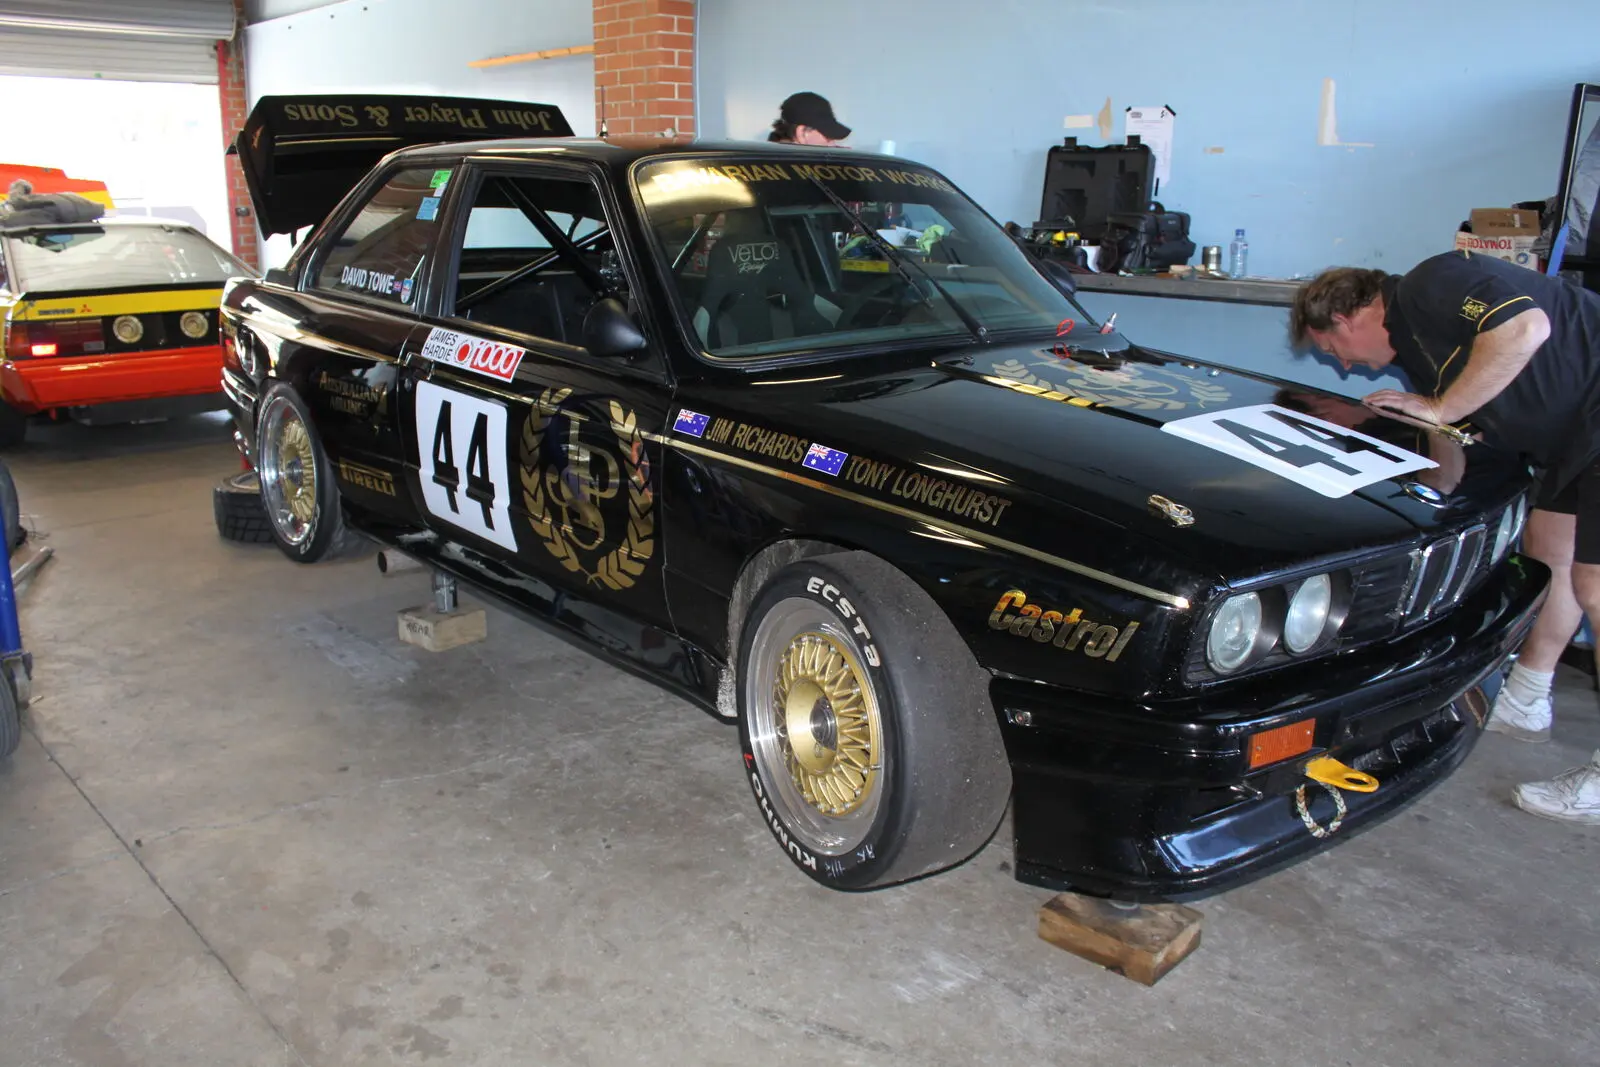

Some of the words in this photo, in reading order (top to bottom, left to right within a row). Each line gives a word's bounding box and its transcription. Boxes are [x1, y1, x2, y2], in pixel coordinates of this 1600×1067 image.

[284, 103, 359, 127] Sons
[364, 105, 391, 127] &
[404, 103, 488, 130] Player
[493, 107, 554, 131] John
[791, 164, 885, 184] MOTOR
[878, 168, 958, 194] WORKS
[341, 265, 368, 288] DAVID
[368, 270, 396, 294] TOWE
[422, 343, 453, 361] HARDIE
[430, 329, 459, 347] JAMES
[473, 342, 518, 374] 1000
[705, 417, 731, 443] JIM
[731, 423, 808, 463] RICHARDS
[1212, 410, 1406, 476] 44
[339, 457, 396, 496] PIRELLI
[432, 400, 495, 531] 44
[845, 455, 891, 492] TONY
[892, 468, 1012, 527] LONGHURST
[988, 589, 1140, 662] Castrol
[752, 772, 817, 872] KUMHO
